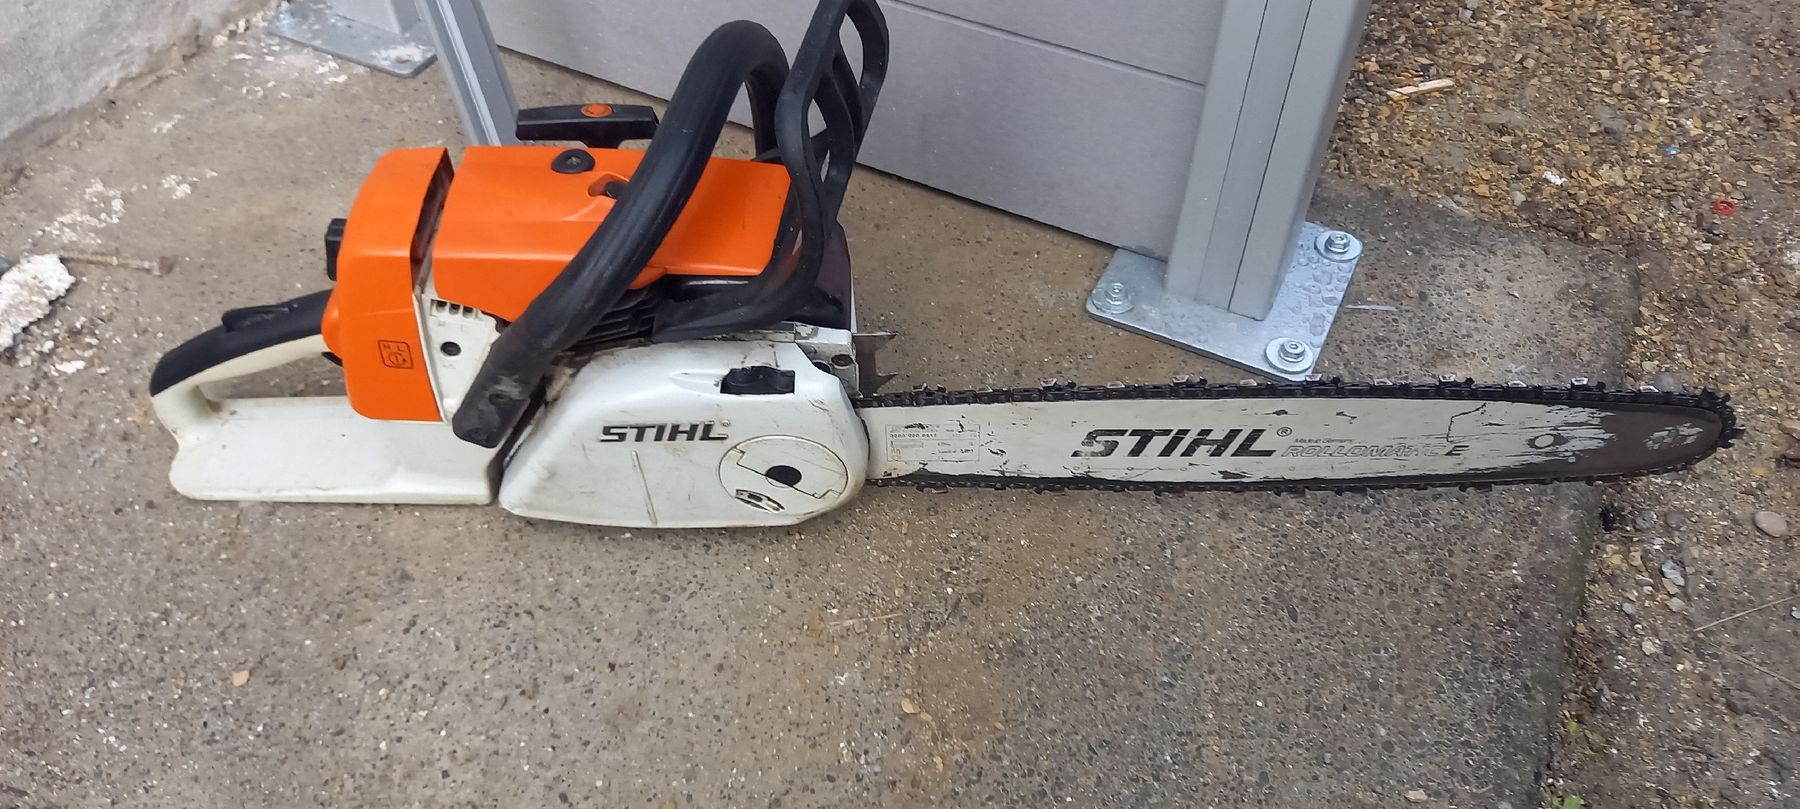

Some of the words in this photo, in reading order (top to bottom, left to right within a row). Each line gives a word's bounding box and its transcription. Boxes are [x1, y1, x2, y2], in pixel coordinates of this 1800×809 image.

[599, 421, 728, 441] STIHL
[1071, 429, 1277, 457] STIHL
[1281, 444, 1447, 457] ROLLOMATC
